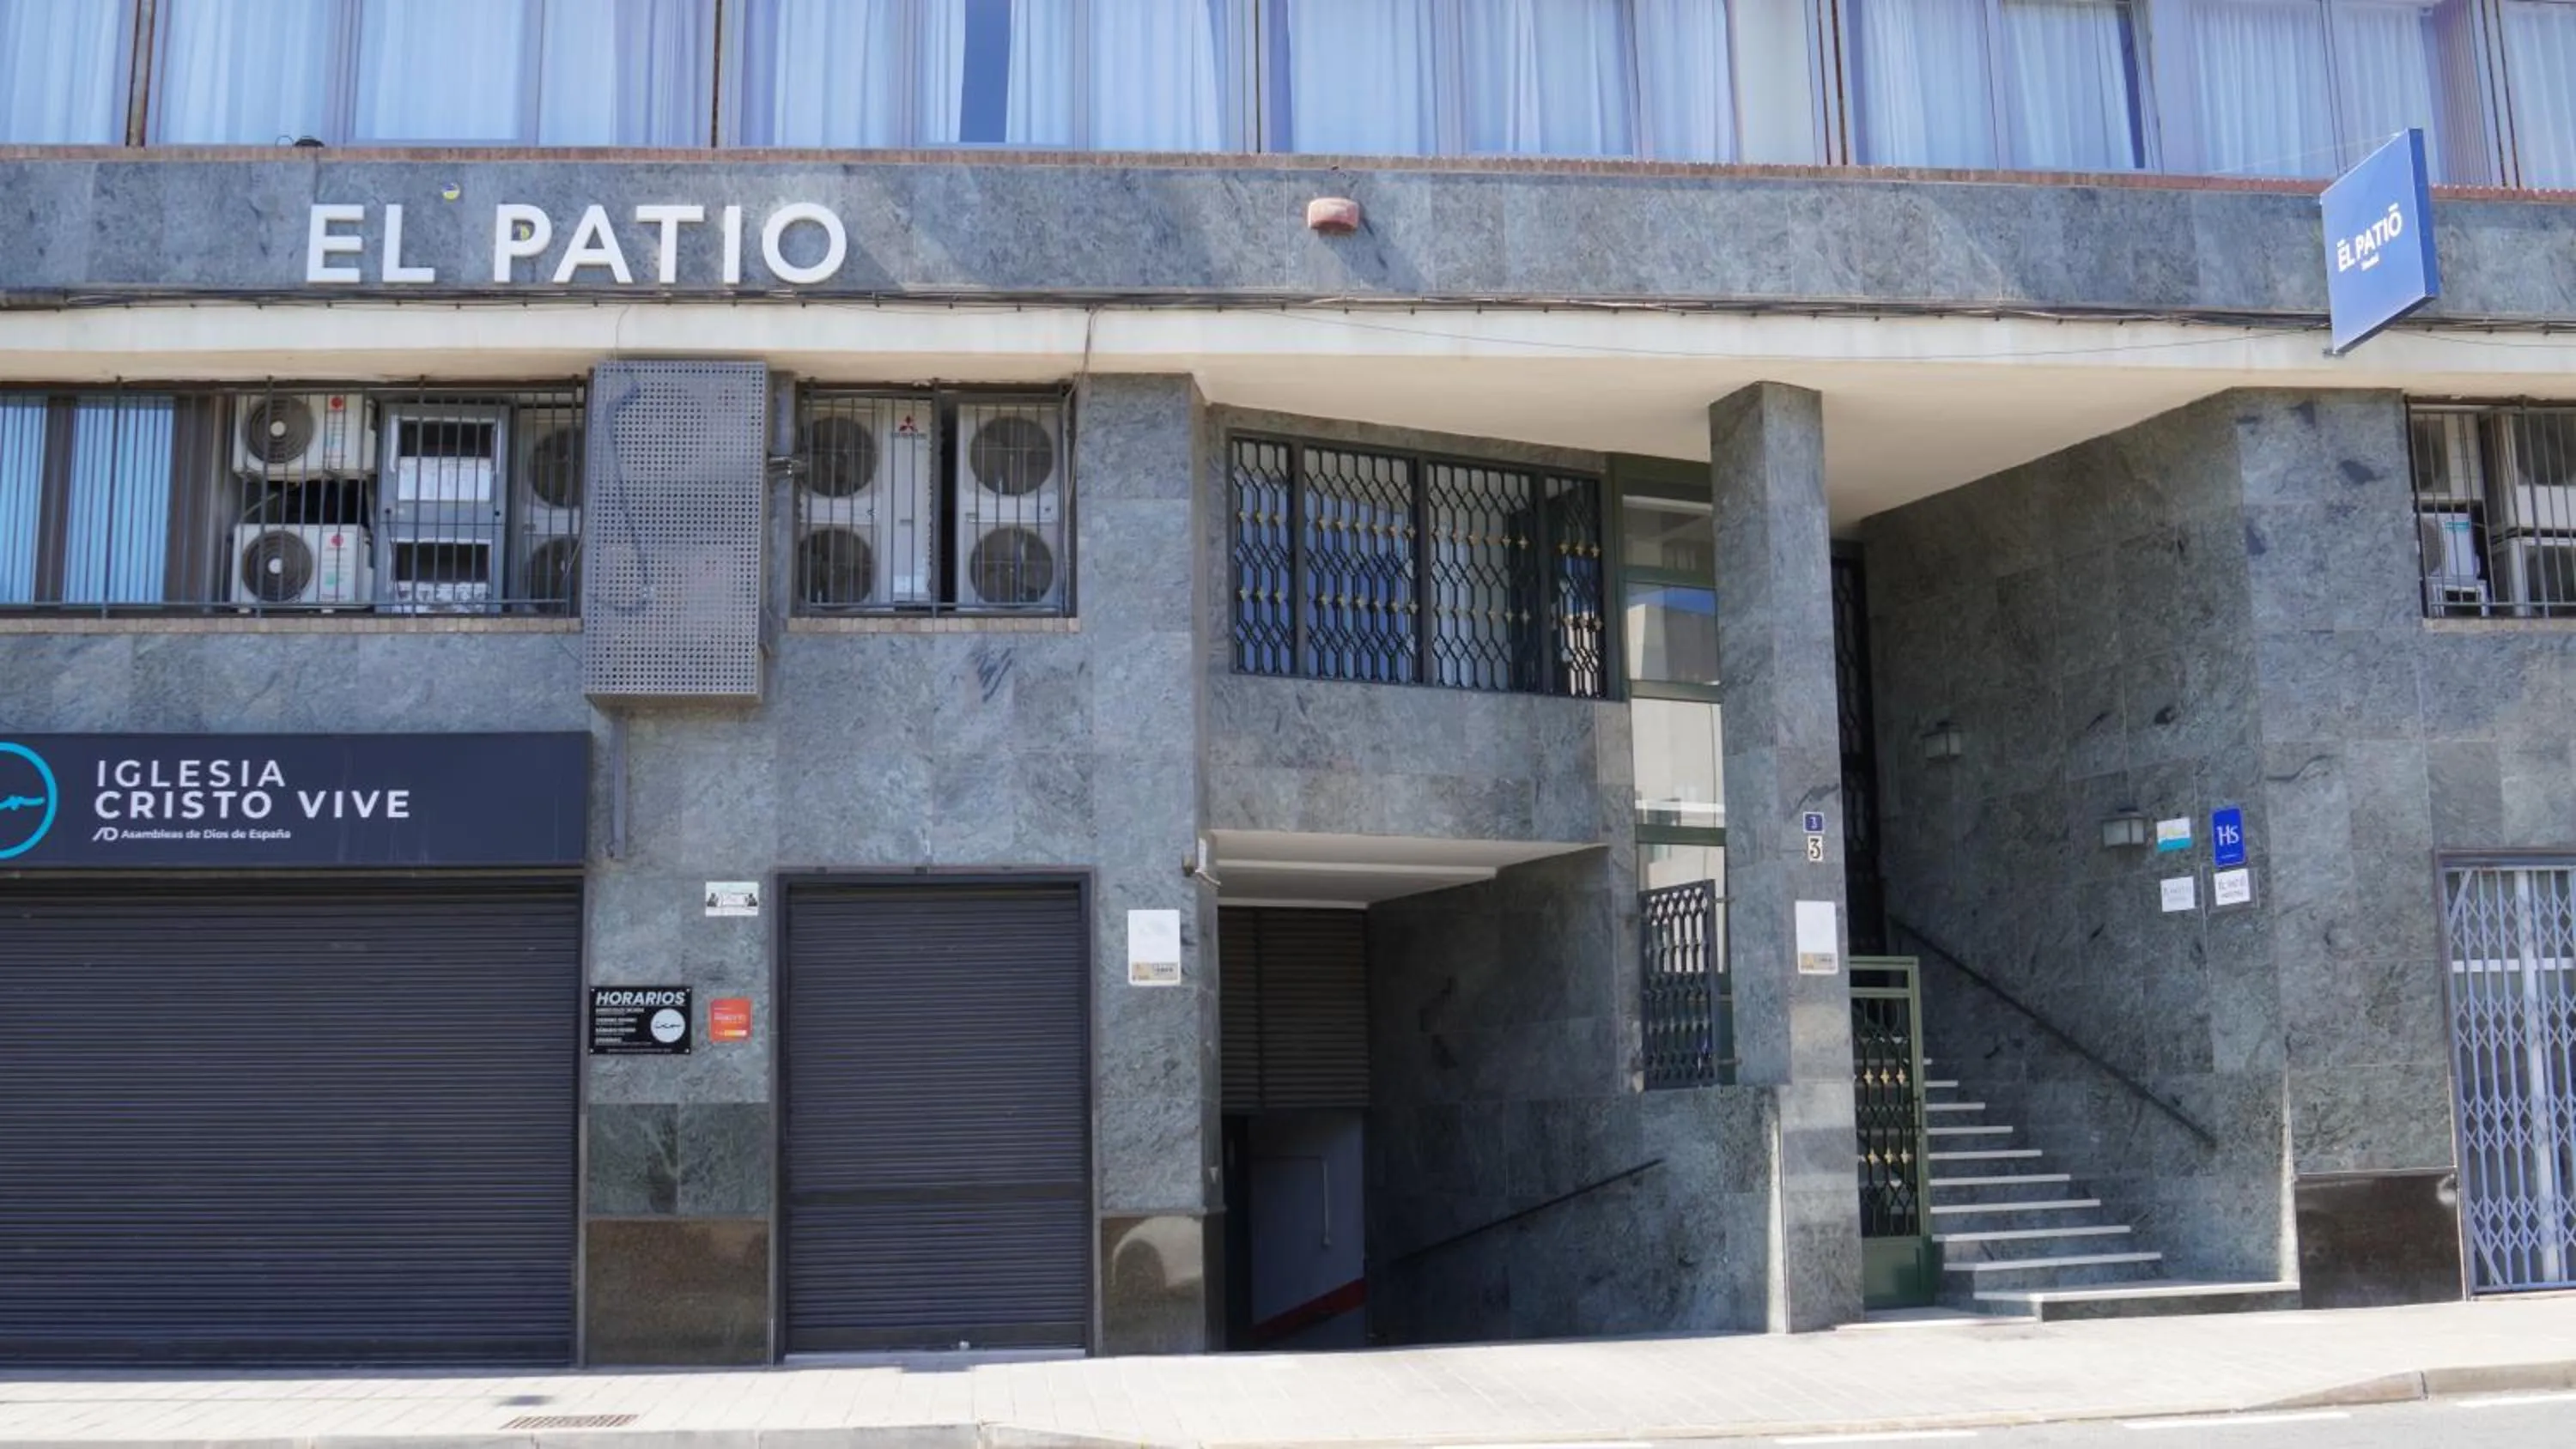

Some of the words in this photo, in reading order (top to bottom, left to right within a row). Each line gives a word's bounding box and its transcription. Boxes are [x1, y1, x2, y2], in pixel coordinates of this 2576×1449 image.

[306, 203, 435, 283] EL
[494, 203, 848, 284] PATIO
[96, 760, 286, 788] IGLESIA
[94, 790, 273, 820] CRISTO
[298, 790, 410, 819] VIVE
[121, 828, 184, 840] Asambleas
[185, 829, 202, 840] de
[204, 829, 229, 840] Dios
[230, 829, 246, 840] de
[248, 829, 292, 842] España
[2216, 824, 2240, 846] HS
[1809, 837, 1821, 859] 3
[595, 991, 687, 1006] HORARIOS
